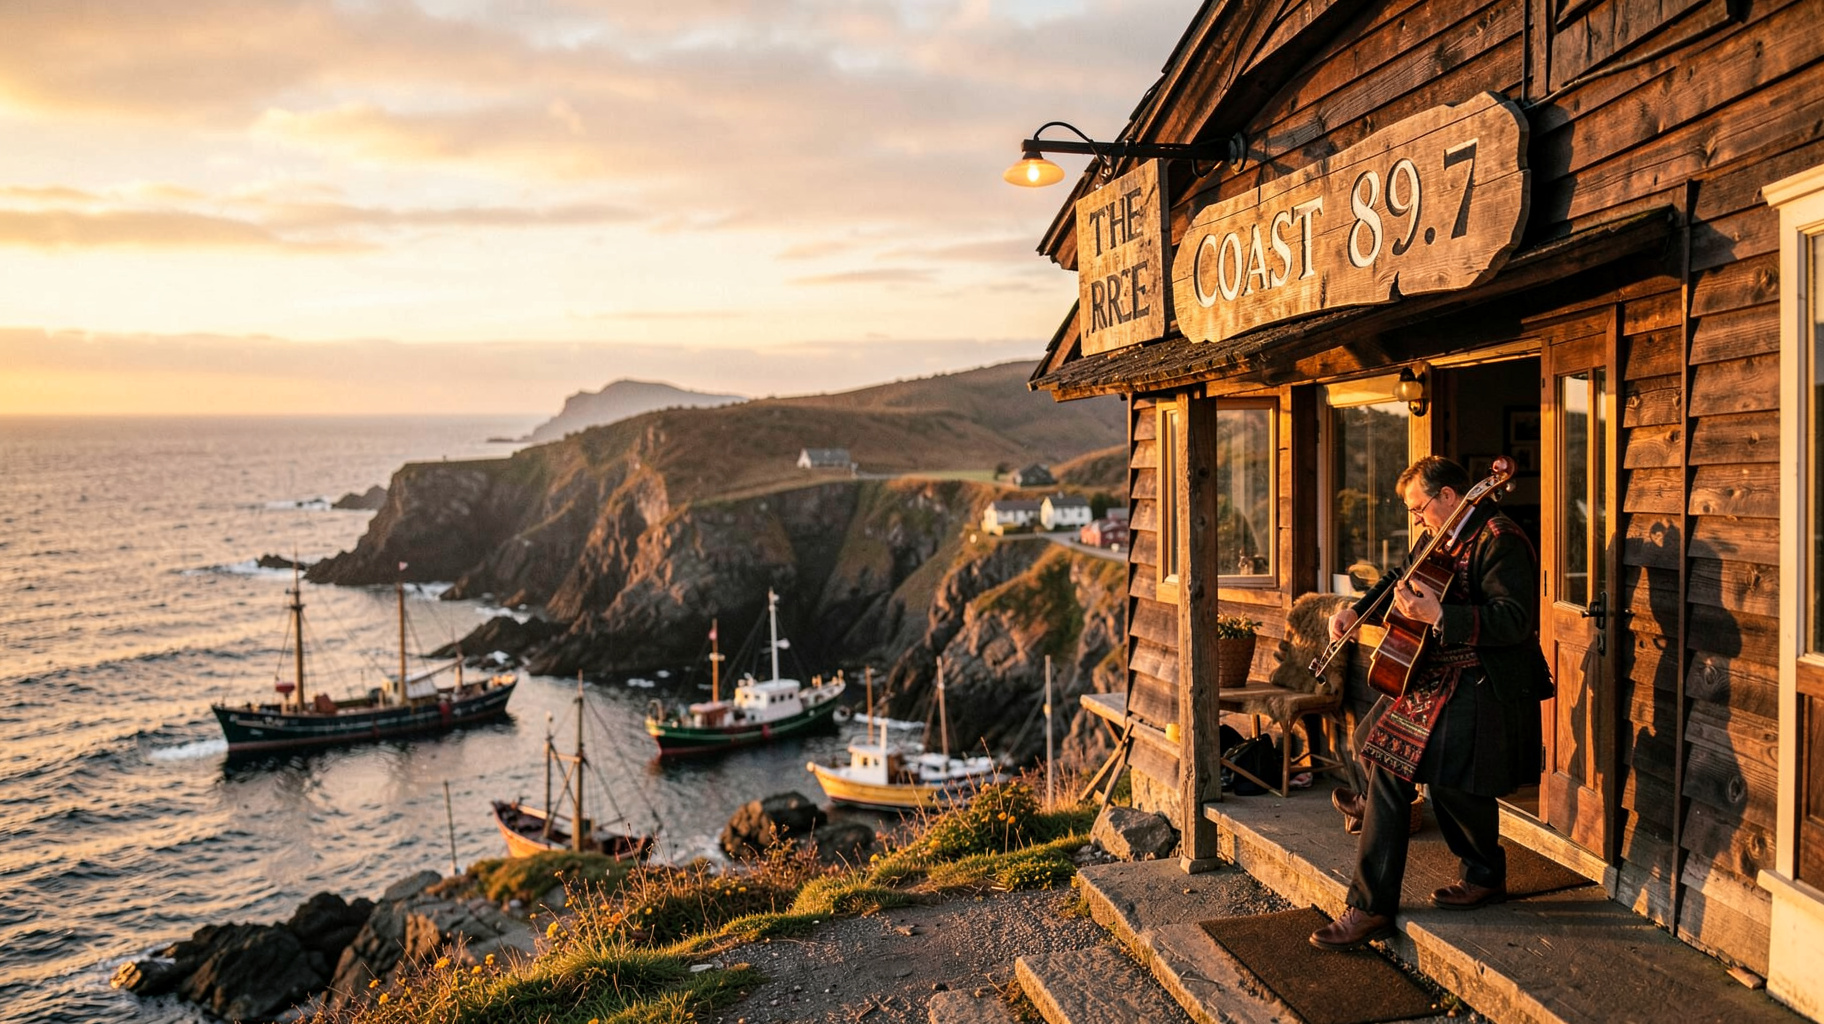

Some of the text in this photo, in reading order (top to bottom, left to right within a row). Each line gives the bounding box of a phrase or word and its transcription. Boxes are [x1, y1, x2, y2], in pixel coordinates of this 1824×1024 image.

[1089, 187, 1143, 257] THE
[1193, 137, 1479, 308] COAST 89.7
